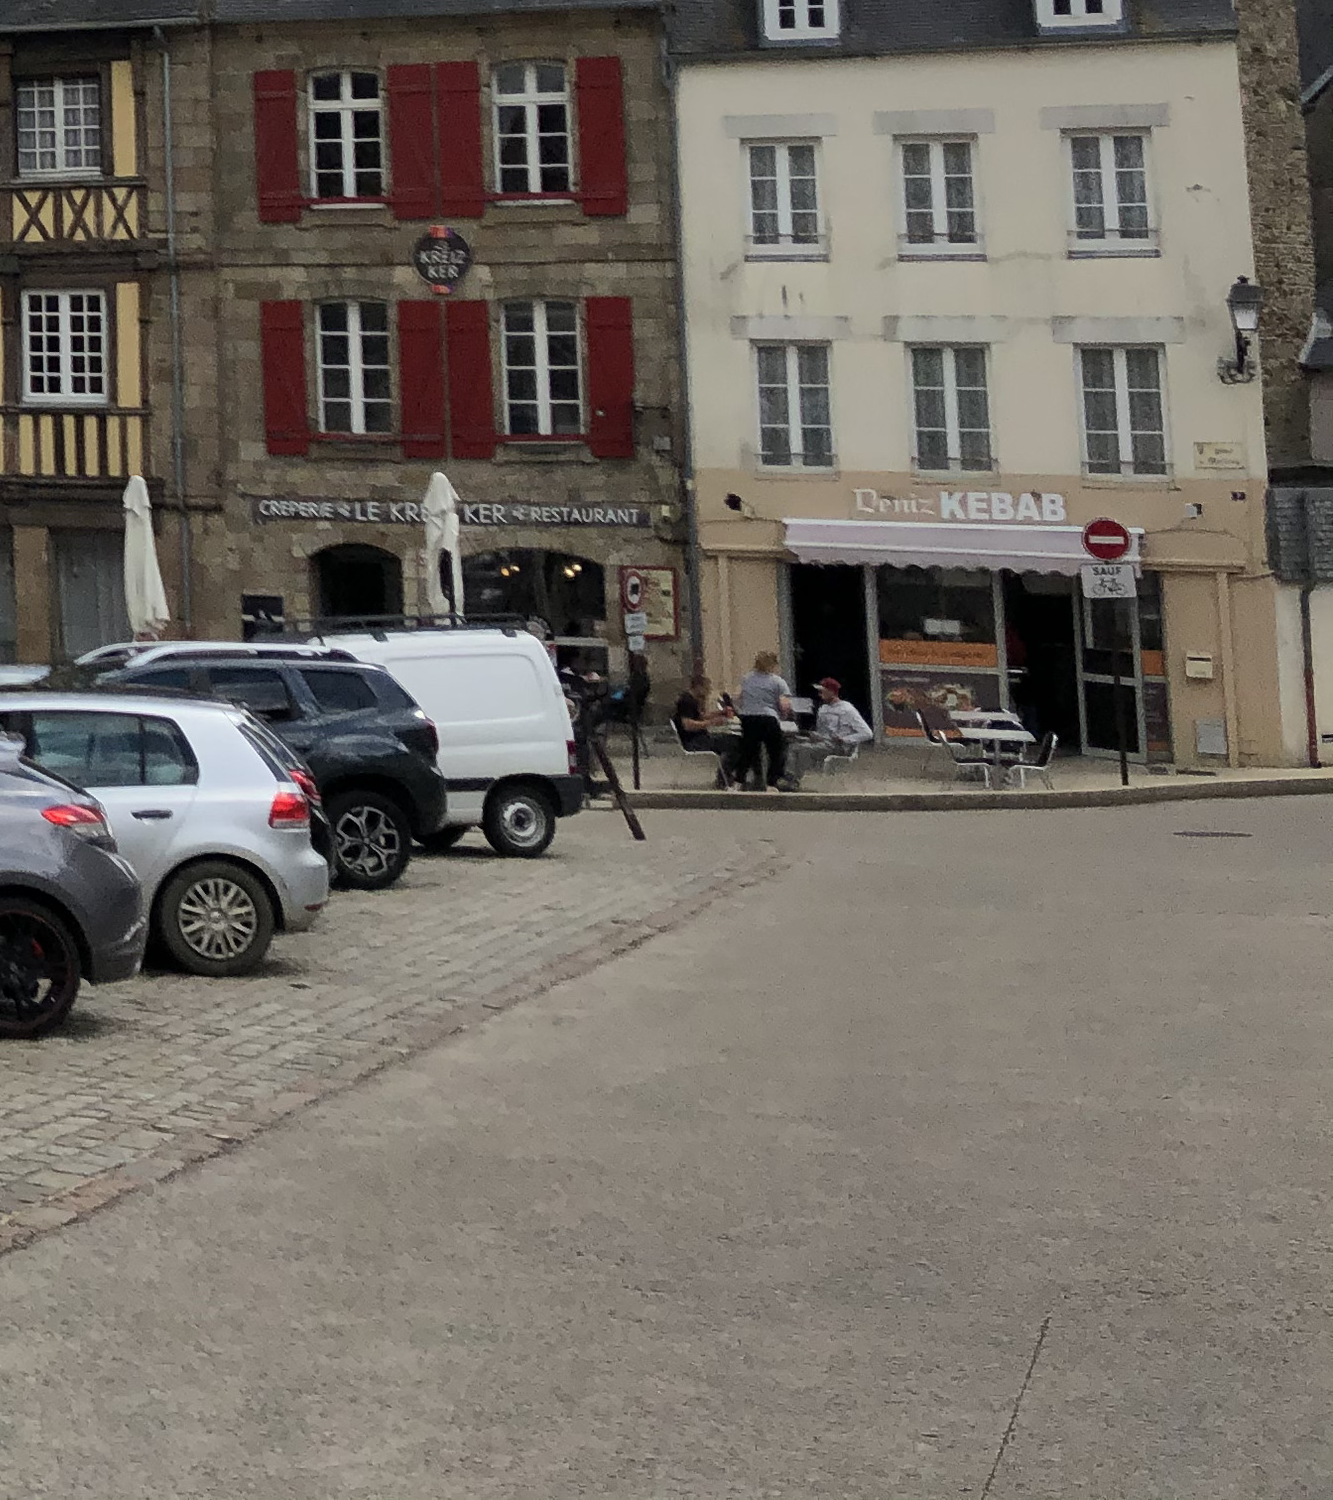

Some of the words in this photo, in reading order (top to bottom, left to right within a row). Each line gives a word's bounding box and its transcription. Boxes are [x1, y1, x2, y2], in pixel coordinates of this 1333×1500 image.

[428, 265, 459, 278] KER
[355, 501, 381, 522] LE
[463, 503, 508, 524] KER
[532, 506, 641, 524] RESTAURANT
[939, 491, 1066, 521] KEBAB
[1093, 566, 1122, 576] SAUF
